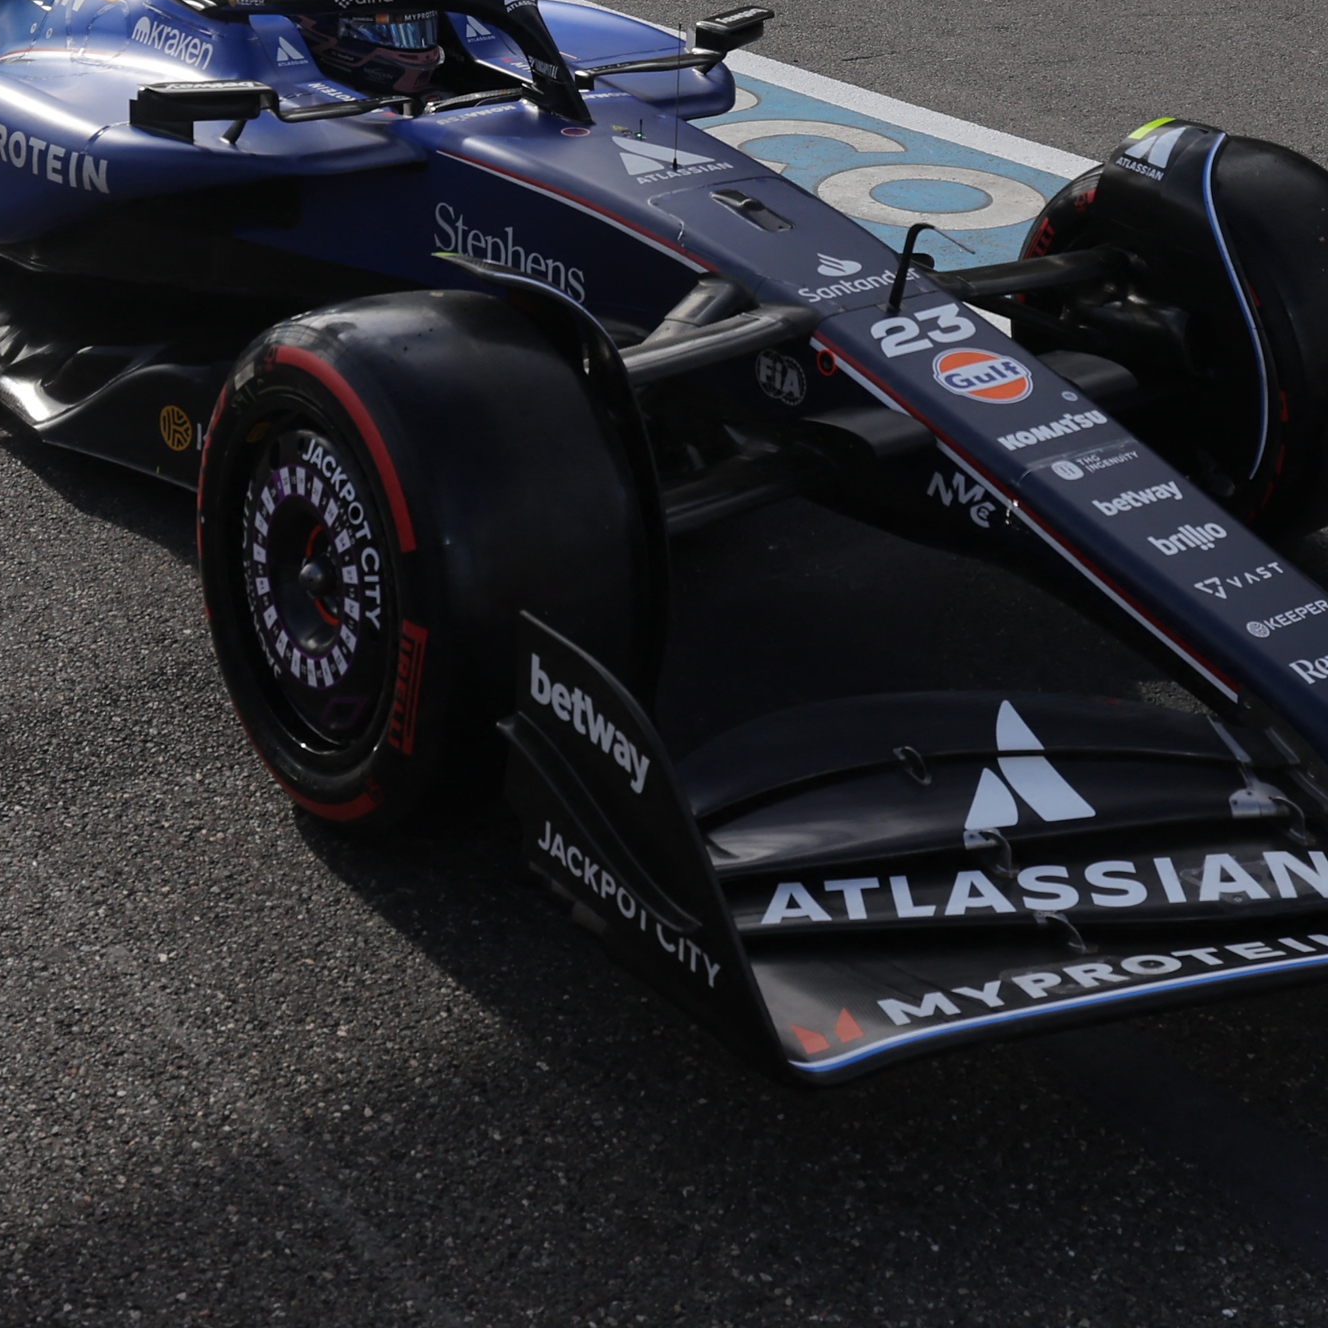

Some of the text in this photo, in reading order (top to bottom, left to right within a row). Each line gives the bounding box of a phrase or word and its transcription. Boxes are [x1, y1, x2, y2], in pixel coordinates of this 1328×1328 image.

[151, 20, 214, 70] kraken
[467, 35, 496, 43] ATLASSIAN
[278, 59, 309, 67] ATLASSIAN
[436, 104, 517, 126] KOMATSU
[635, 161, 735, 185] ATLASSIAN
[1115, 156, 1165, 182] ATLASSIAN
[434, 201, 586, 304] Stephens
[798, 267, 920, 304] Santander
[870, 303, 977, 358] 23
[944, 358, 1024, 392] Gulf
[997, 409, 1108, 451] KOMATSU
[1076, 454, 1102, 467] THG
[1084, 450, 1139, 474] INGENUITY
[1091, 481, 1183, 517] betway
[302, 438, 374, 541] JACKPOT
[360, 545, 382, 631] CITY
[1147, 521, 1228, 556] brillio
[1226, 562, 1284, 589] VAST
[530, 652, 650, 795] betway
[656, 923, 721, 989] CITY
